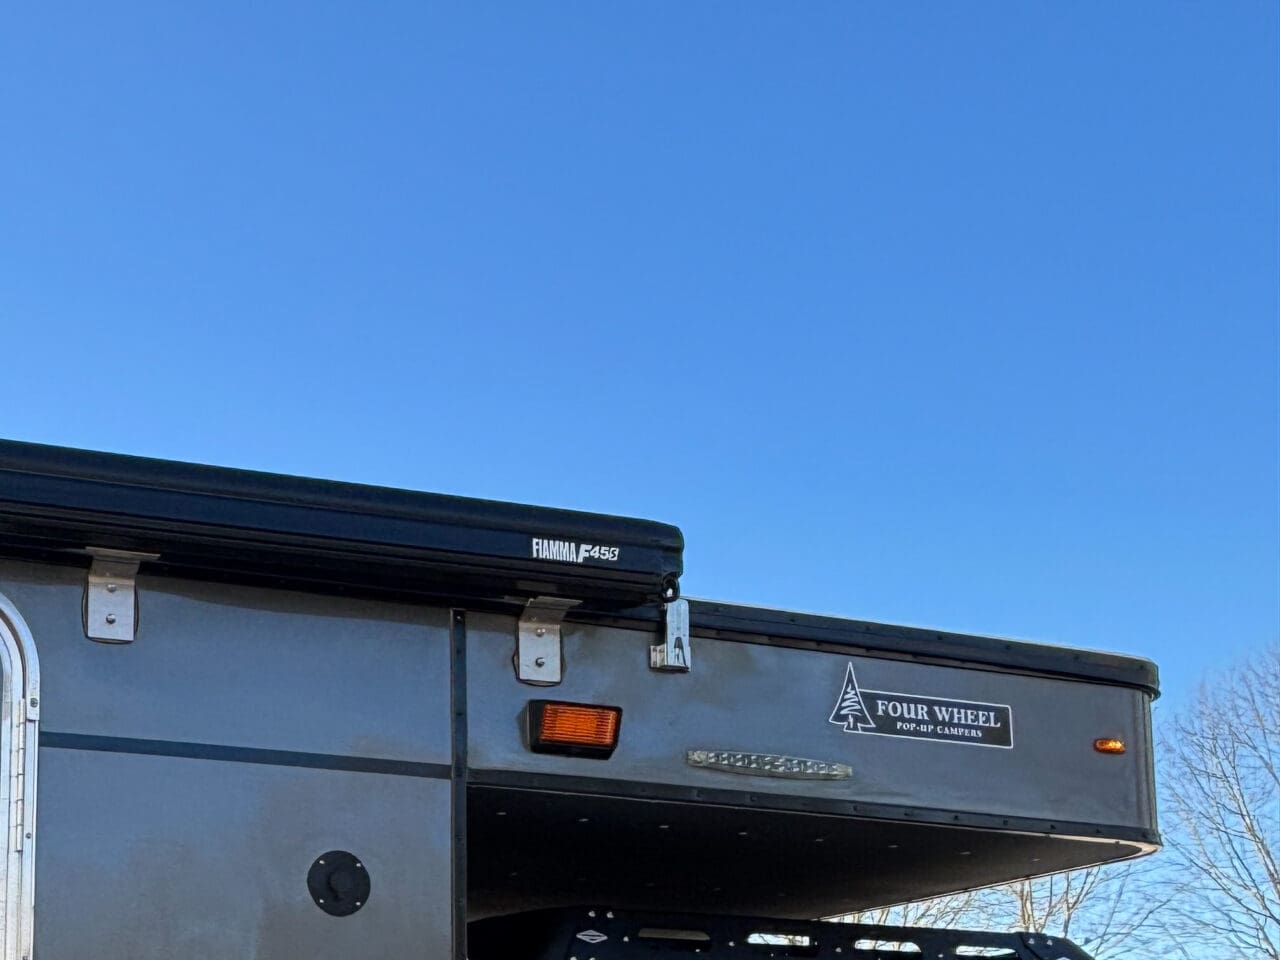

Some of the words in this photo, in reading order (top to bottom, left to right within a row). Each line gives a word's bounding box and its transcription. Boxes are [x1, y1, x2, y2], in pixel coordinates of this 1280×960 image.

[532, 538, 577, 562] FIAMMA
[876, 699, 929, 721] FOUR
[933, 706, 1001, 728] WHEEL
[896, 721, 934, 734] POP-UP
[937, 725, 983, 738] CAMPERS
